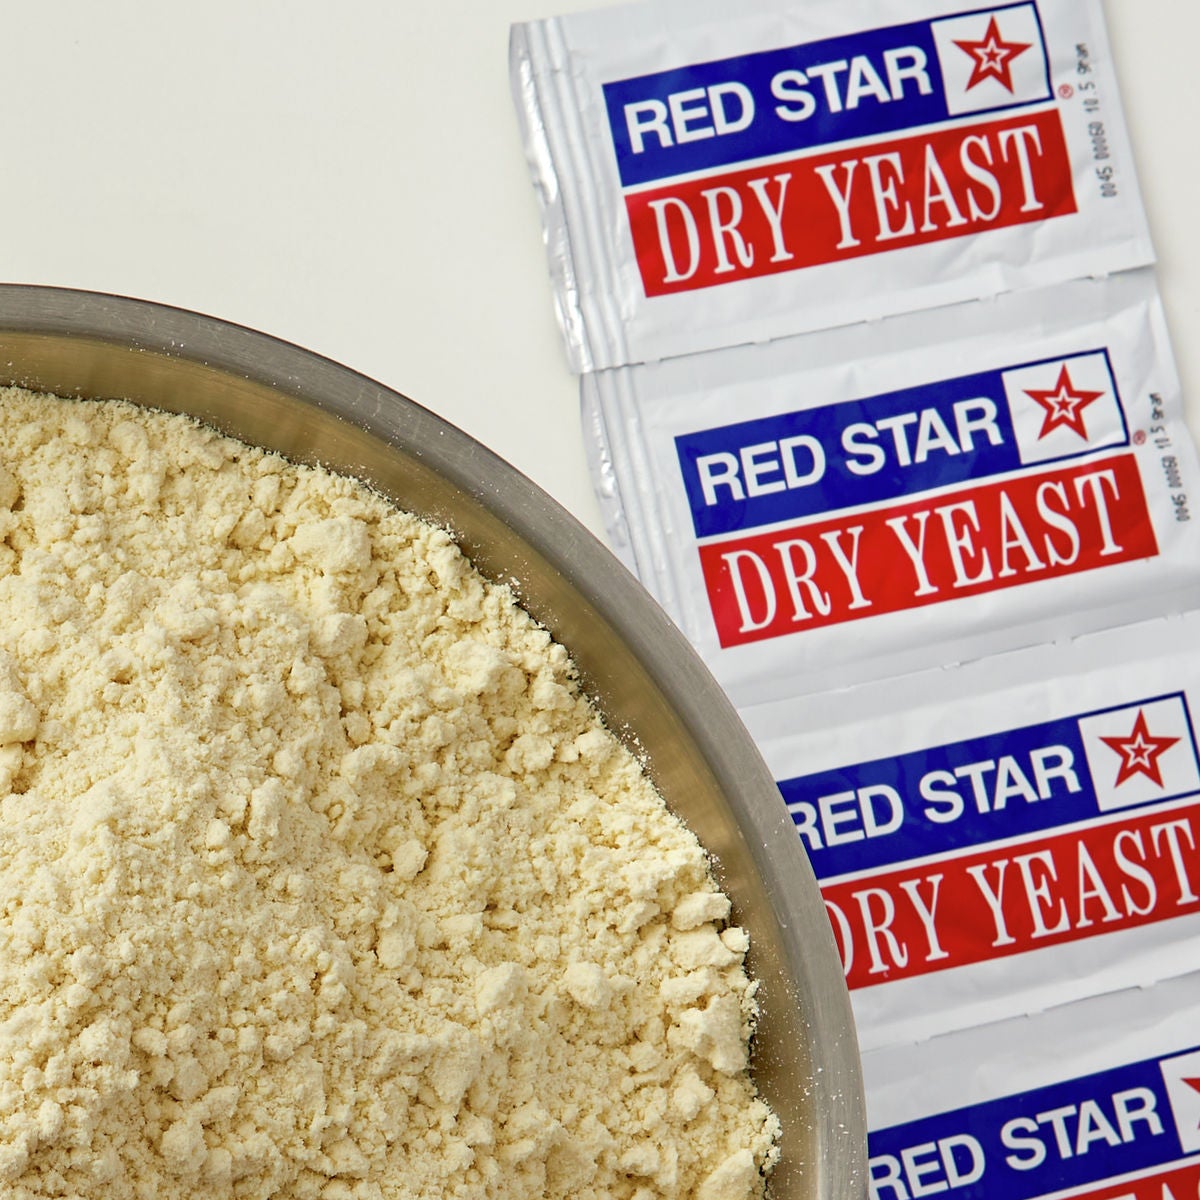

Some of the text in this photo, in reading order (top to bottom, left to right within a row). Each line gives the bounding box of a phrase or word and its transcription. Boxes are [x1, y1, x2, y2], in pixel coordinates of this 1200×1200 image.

[623, 45, 933, 154] RED STAR
[647, 124, 1044, 284] DRY YEAST
[695, 396, 1004, 506] RED STAR
[720, 468, 1123, 633] DRY YEAST
[787, 744, 1082, 851] RED STAR
[965, 818, 1199, 947] YEAST
[1000, 1087, 1165, 1171] STAR
